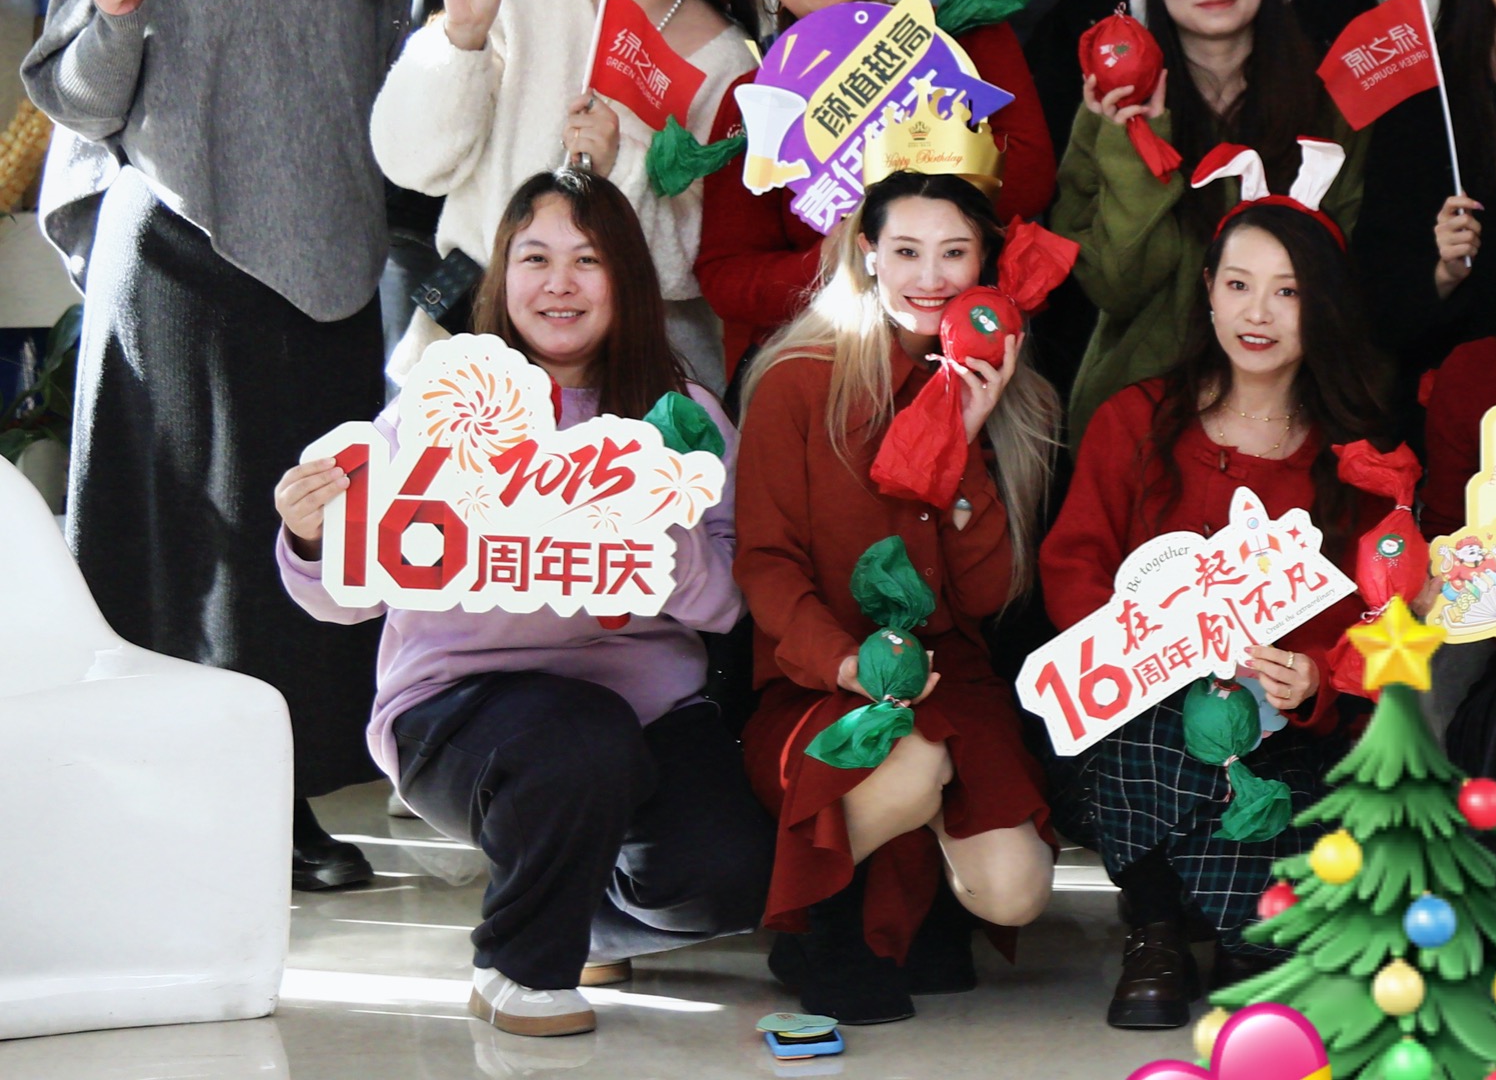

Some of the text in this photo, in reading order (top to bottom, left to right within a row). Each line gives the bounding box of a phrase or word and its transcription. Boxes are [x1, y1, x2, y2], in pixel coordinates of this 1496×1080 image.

[606, 56, 662, 110] GREEN SOURCE
[609, 28, 672, 99] 绿之源
[811, 13, 932, 139] 颜值越高
[886, 149, 963, 169] Happy Birthday
[333, 443, 657, 596] 16周年庆
[1116, 550, 1250, 655] 在一起
[1126, 545, 1191, 593] Be together
[1265, 587, 1337, 635] Create the extraordinary
[1197, 562, 1329, 662] 创不凡
[1035, 635, 1199, 742] 16周年
